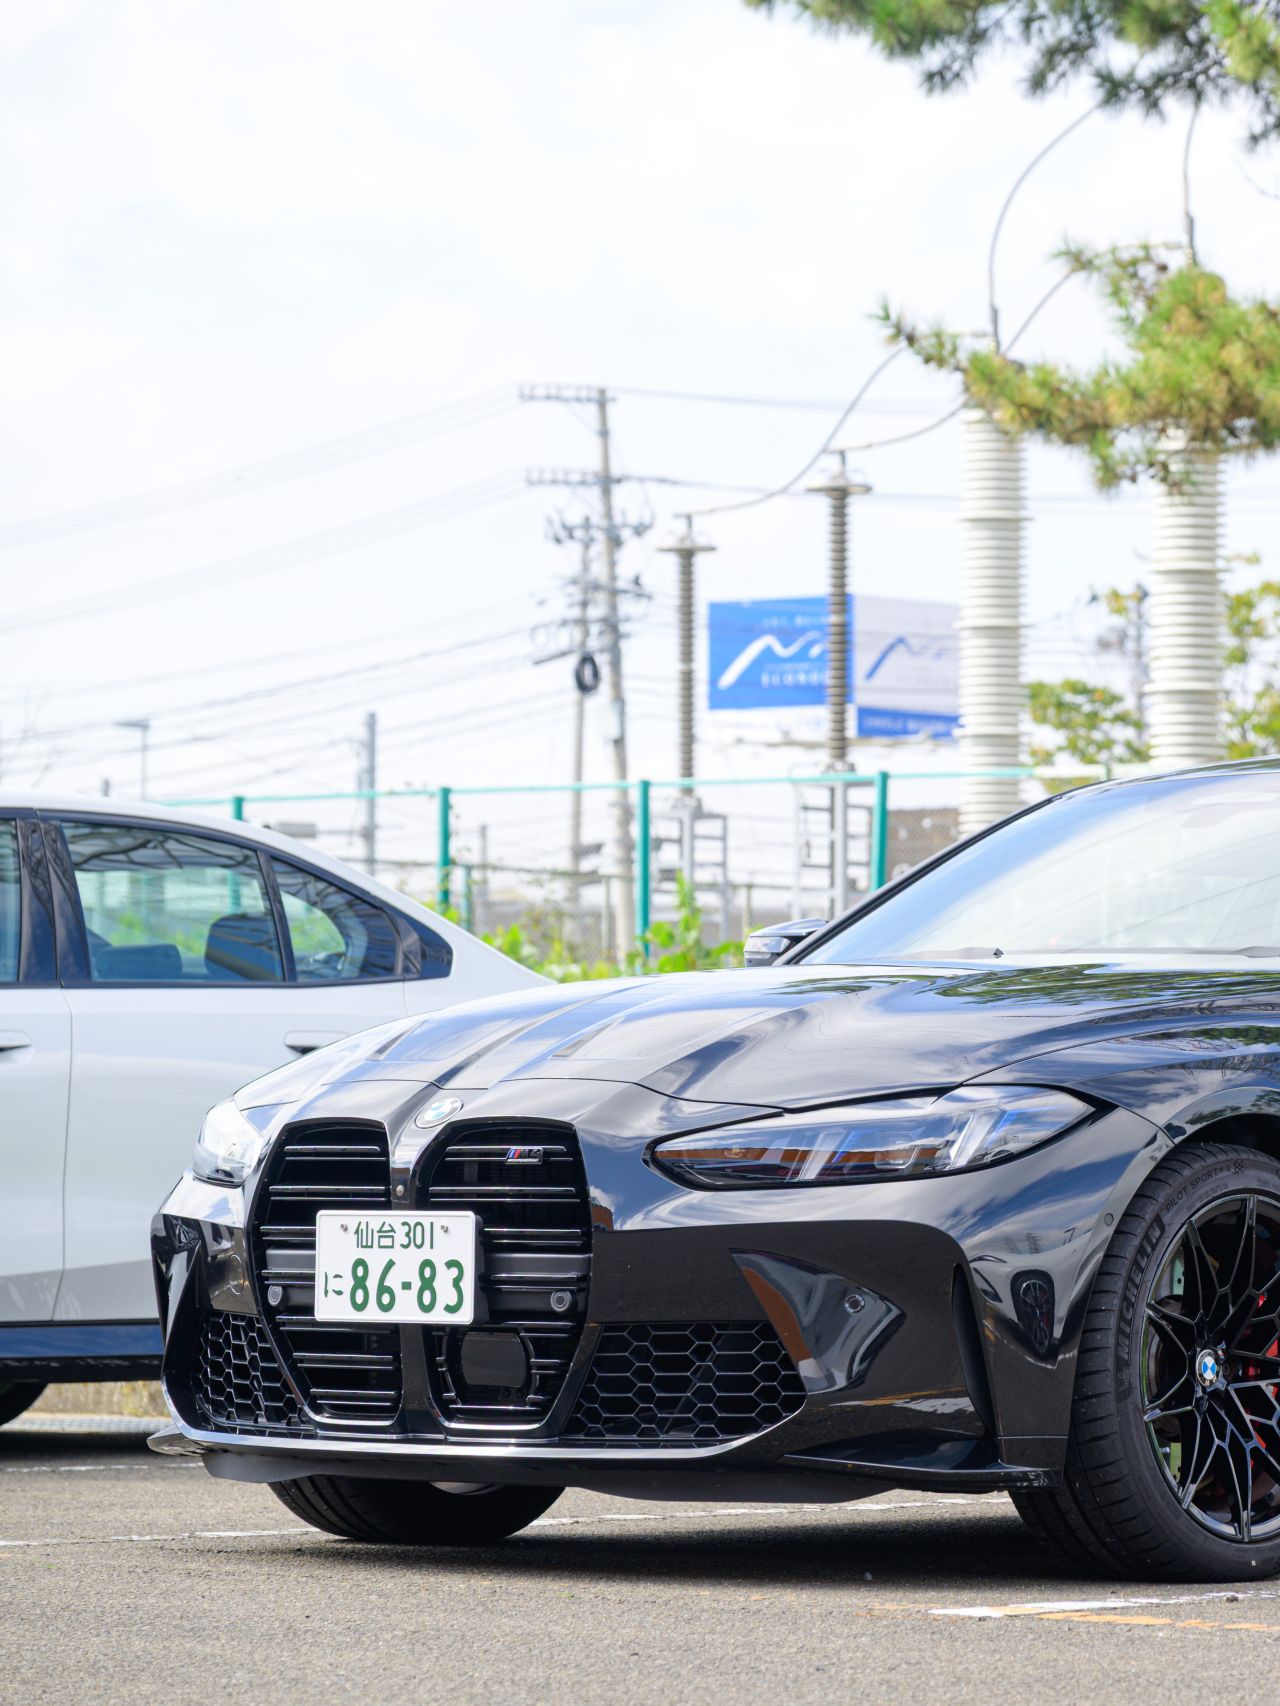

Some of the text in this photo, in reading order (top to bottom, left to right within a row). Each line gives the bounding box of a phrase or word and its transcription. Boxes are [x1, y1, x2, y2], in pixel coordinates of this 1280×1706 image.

[1165, 1186, 1188, 1213] PILOT
[1190, 1167, 1218, 1190] SPORT
[323, 1257, 464, 1314] に 86-83
[1117, 1221, 1162, 1361] MICHELIN
